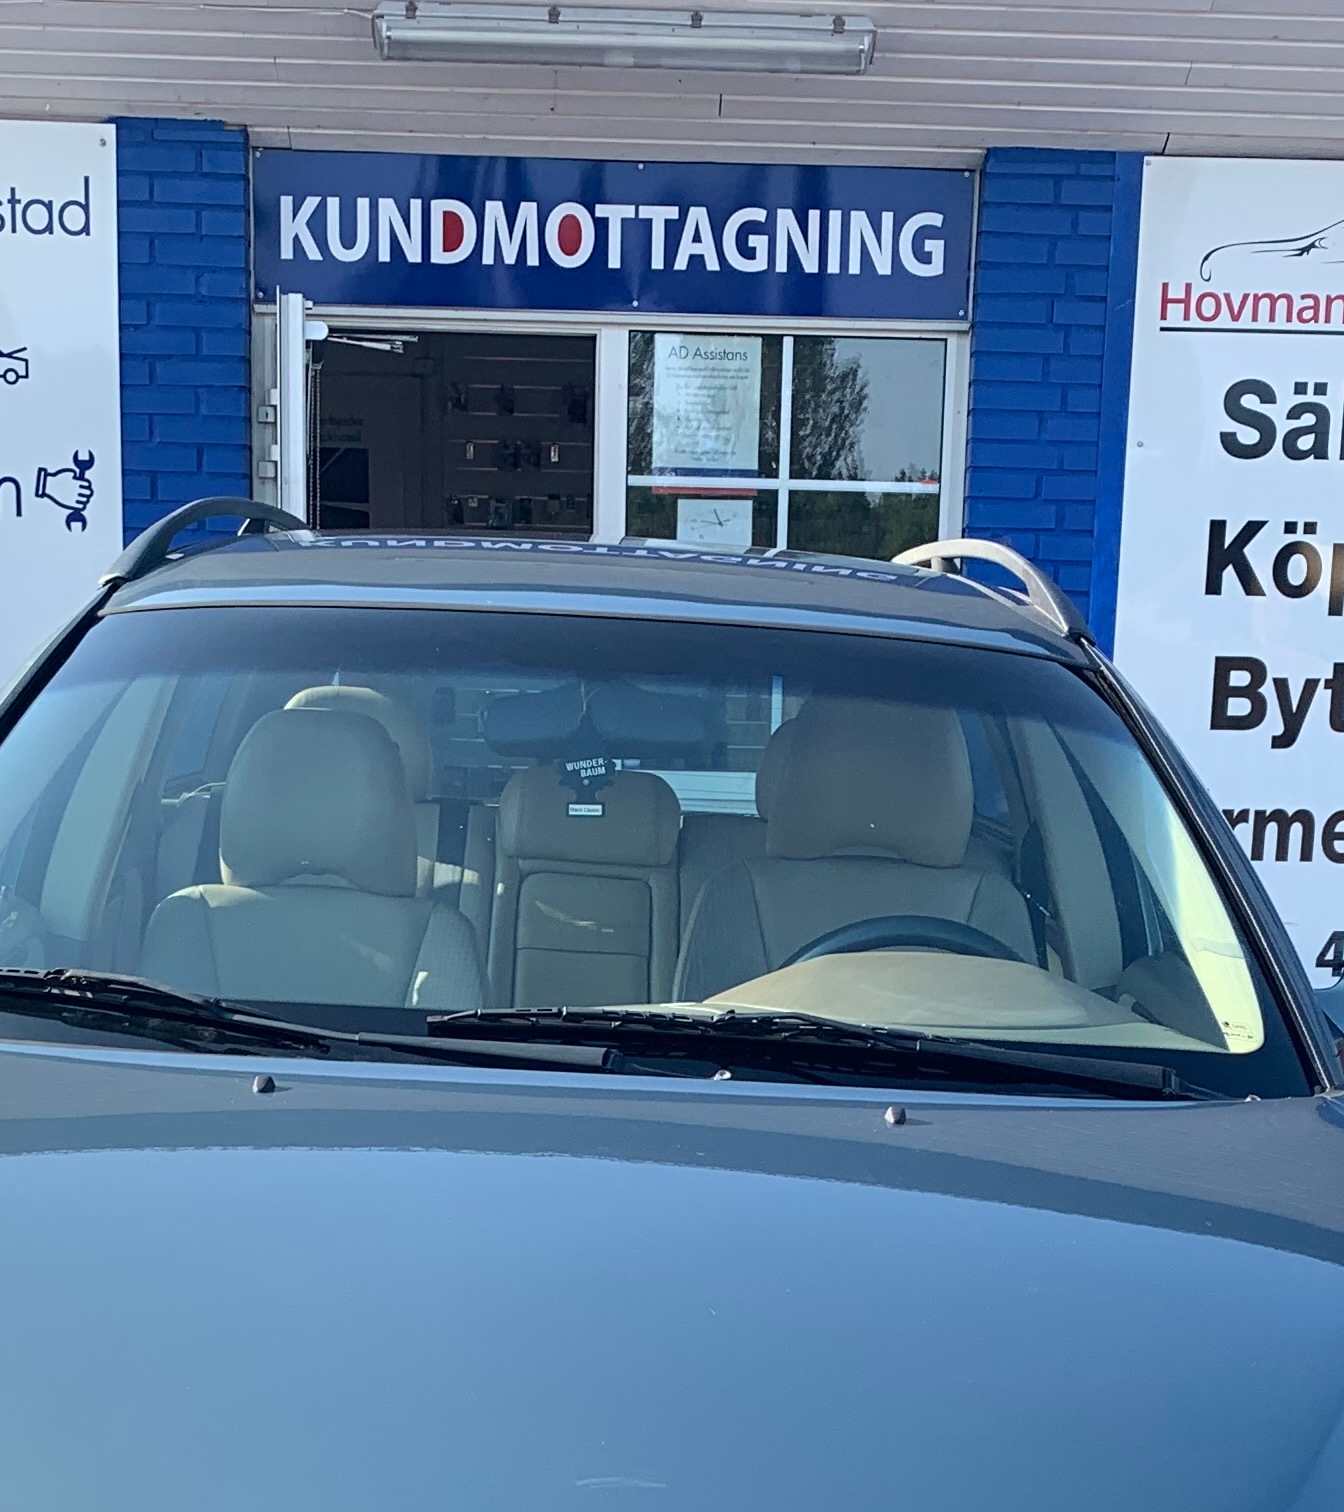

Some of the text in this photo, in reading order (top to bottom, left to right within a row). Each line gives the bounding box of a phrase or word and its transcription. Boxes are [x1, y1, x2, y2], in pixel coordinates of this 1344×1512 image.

[278, 194, 946, 280] KUNDMOTTAGNING
[668, 345, 748, 361] AD Assistans
[566, 757, 607, 771] WUNDER-
[580, 766, 606, 777] BAUM
